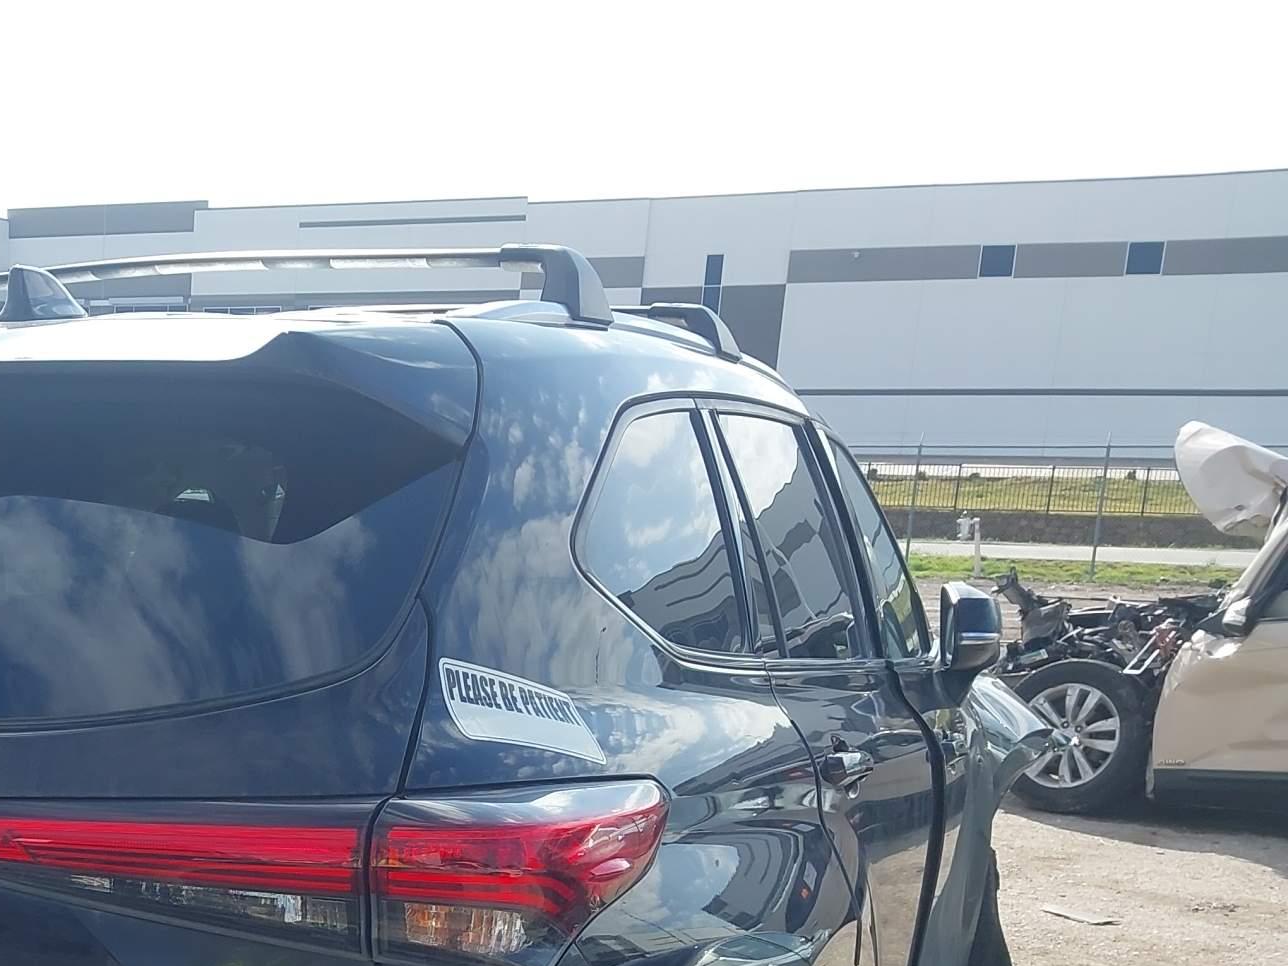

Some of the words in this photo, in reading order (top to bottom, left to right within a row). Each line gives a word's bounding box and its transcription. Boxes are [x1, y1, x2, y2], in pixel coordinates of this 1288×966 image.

[446, 667, 501, 710] PLEASE
[499, 681, 522, 713] BE
[518, 686, 582, 728] PATIENT
